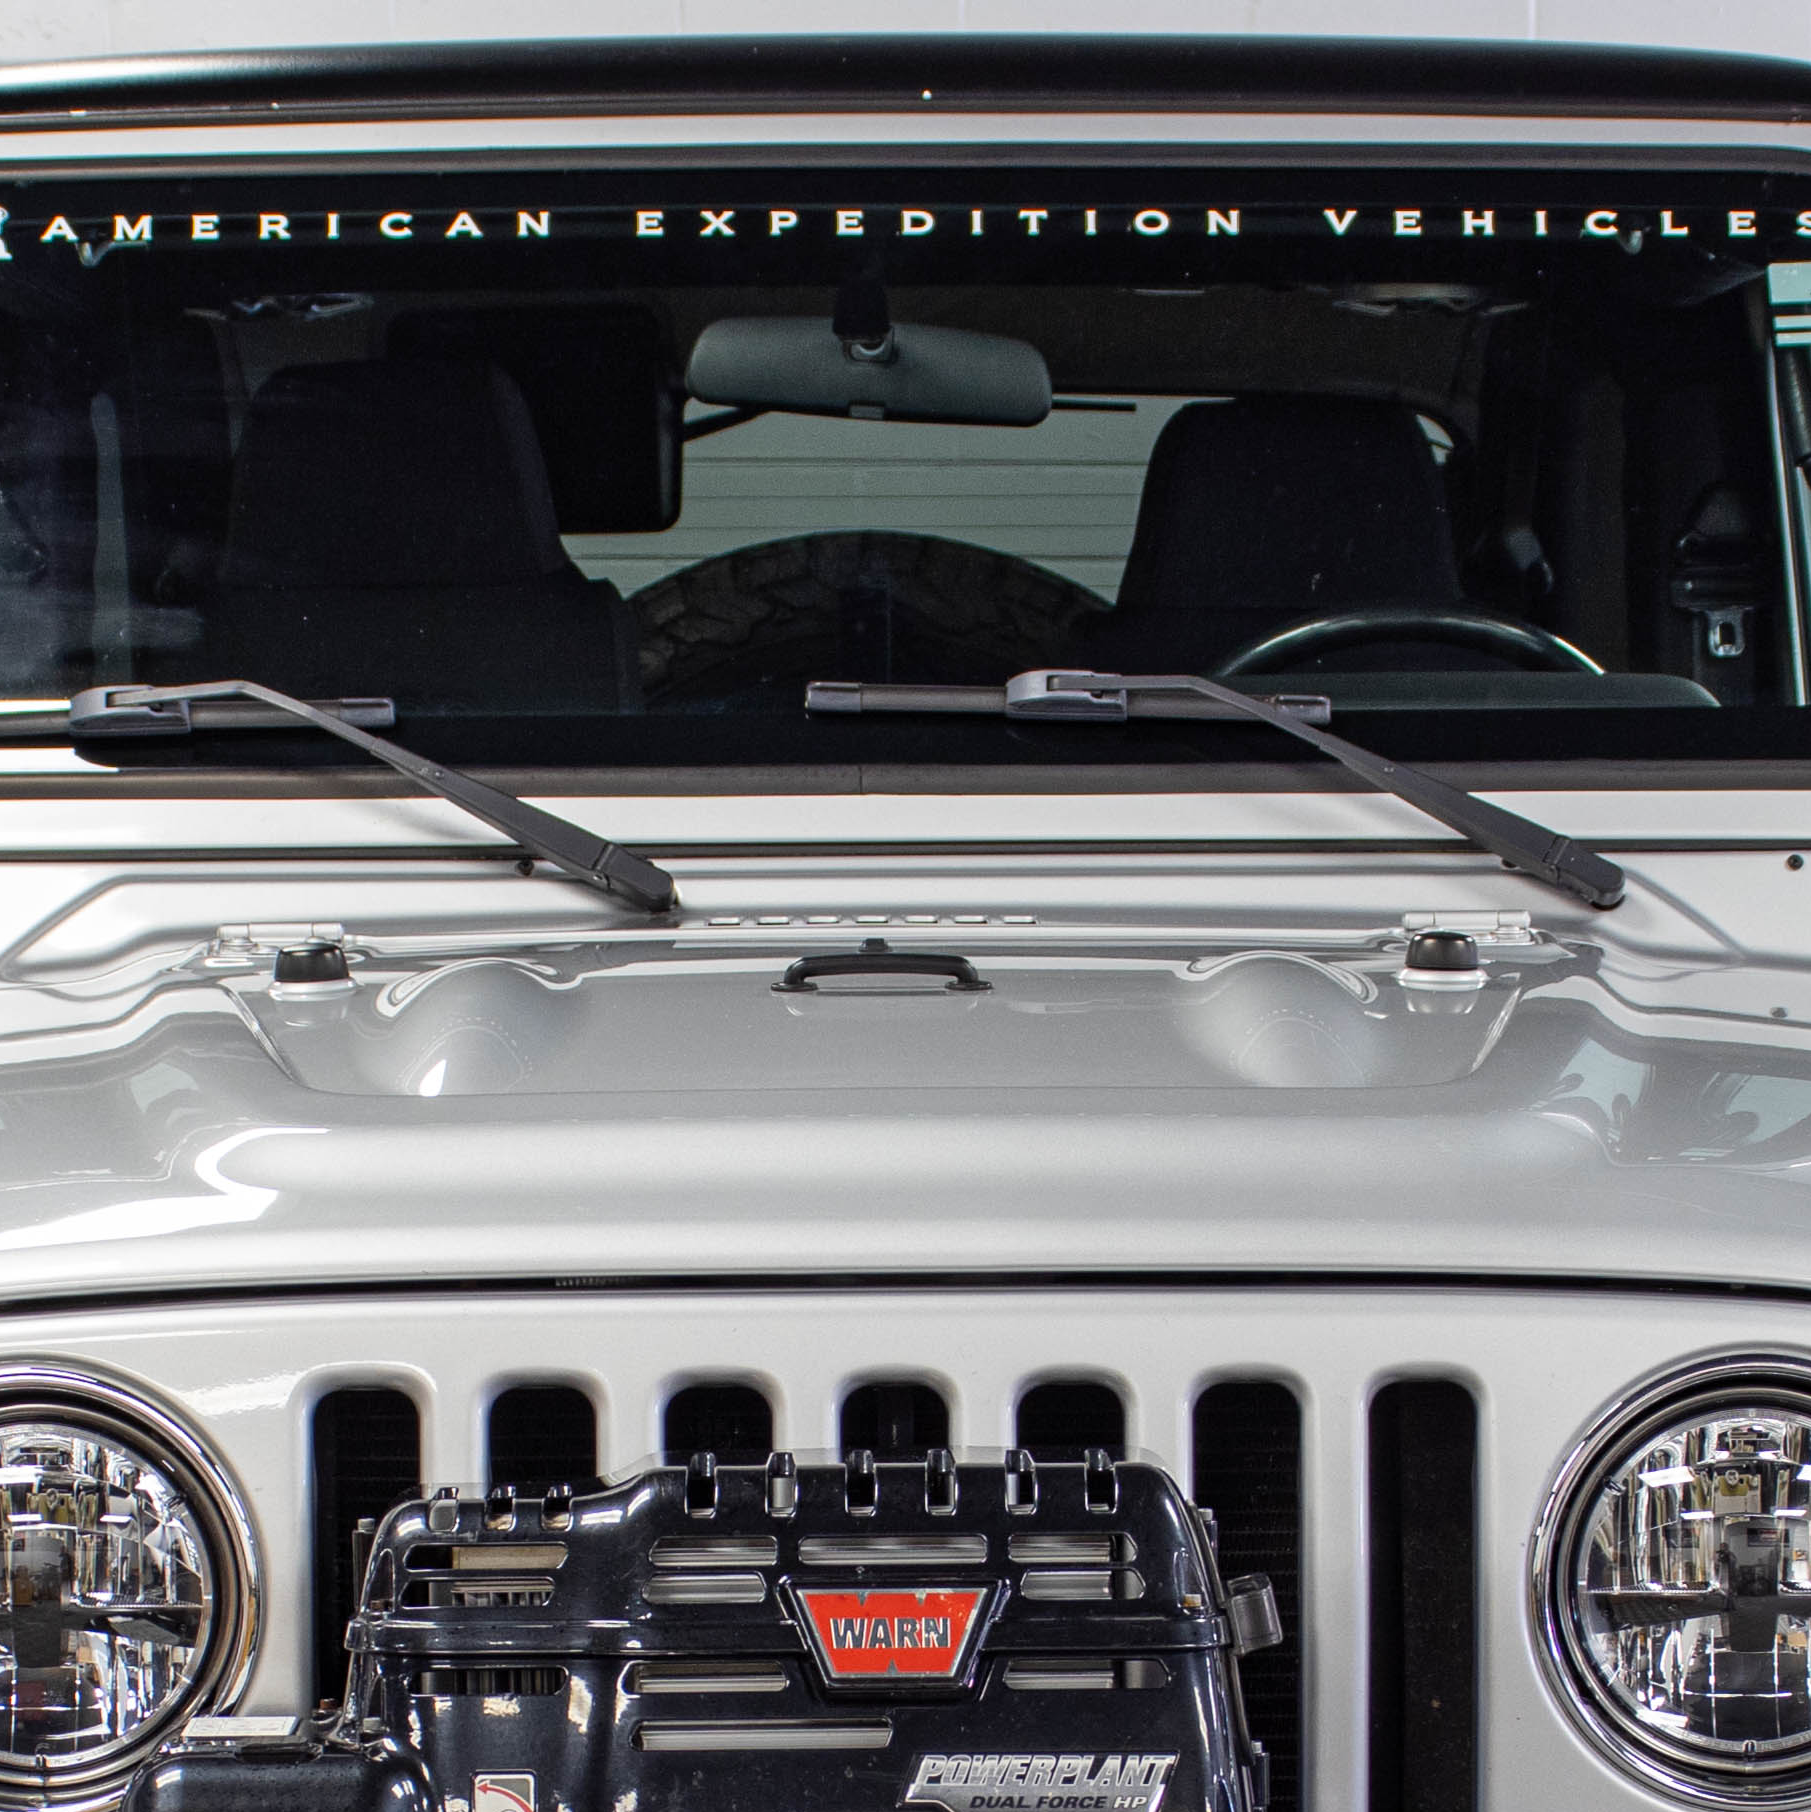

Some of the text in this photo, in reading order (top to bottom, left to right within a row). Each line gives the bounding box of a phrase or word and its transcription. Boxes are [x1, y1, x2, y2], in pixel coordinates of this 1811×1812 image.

[40, 211, 549, 241] AMERICAN
[636, 210, 1239, 236] EXPEDITION
[829, 1616, 951, 1649] WARN
[914, 1754, 1176, 1787] POWERPLANT
[969, 1795, 1148, 1809] DUAL FORCE HP
